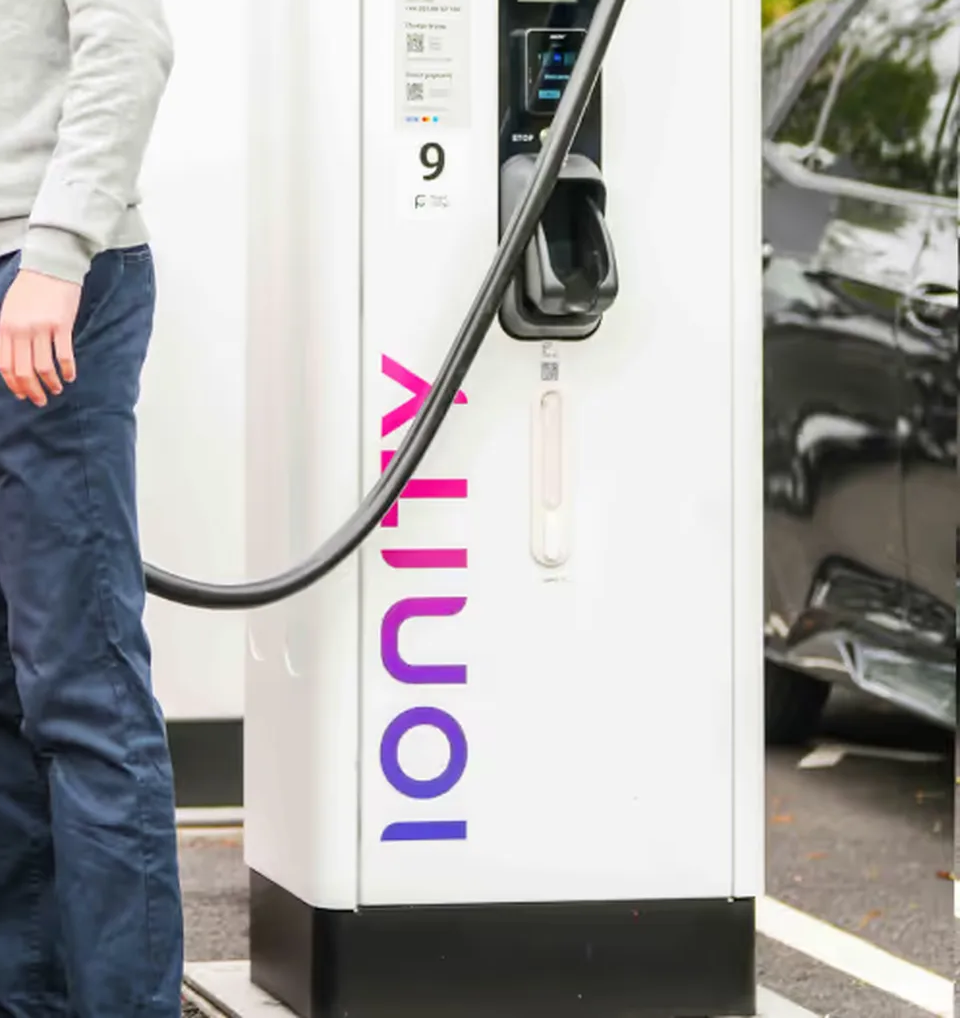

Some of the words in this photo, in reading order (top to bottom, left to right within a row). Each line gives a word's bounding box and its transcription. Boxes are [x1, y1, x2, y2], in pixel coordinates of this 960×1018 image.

[511, 133, 535, 143] STOP
[419, 142, 445, 182] 9
[380, 353, 468, 841] IONITY
